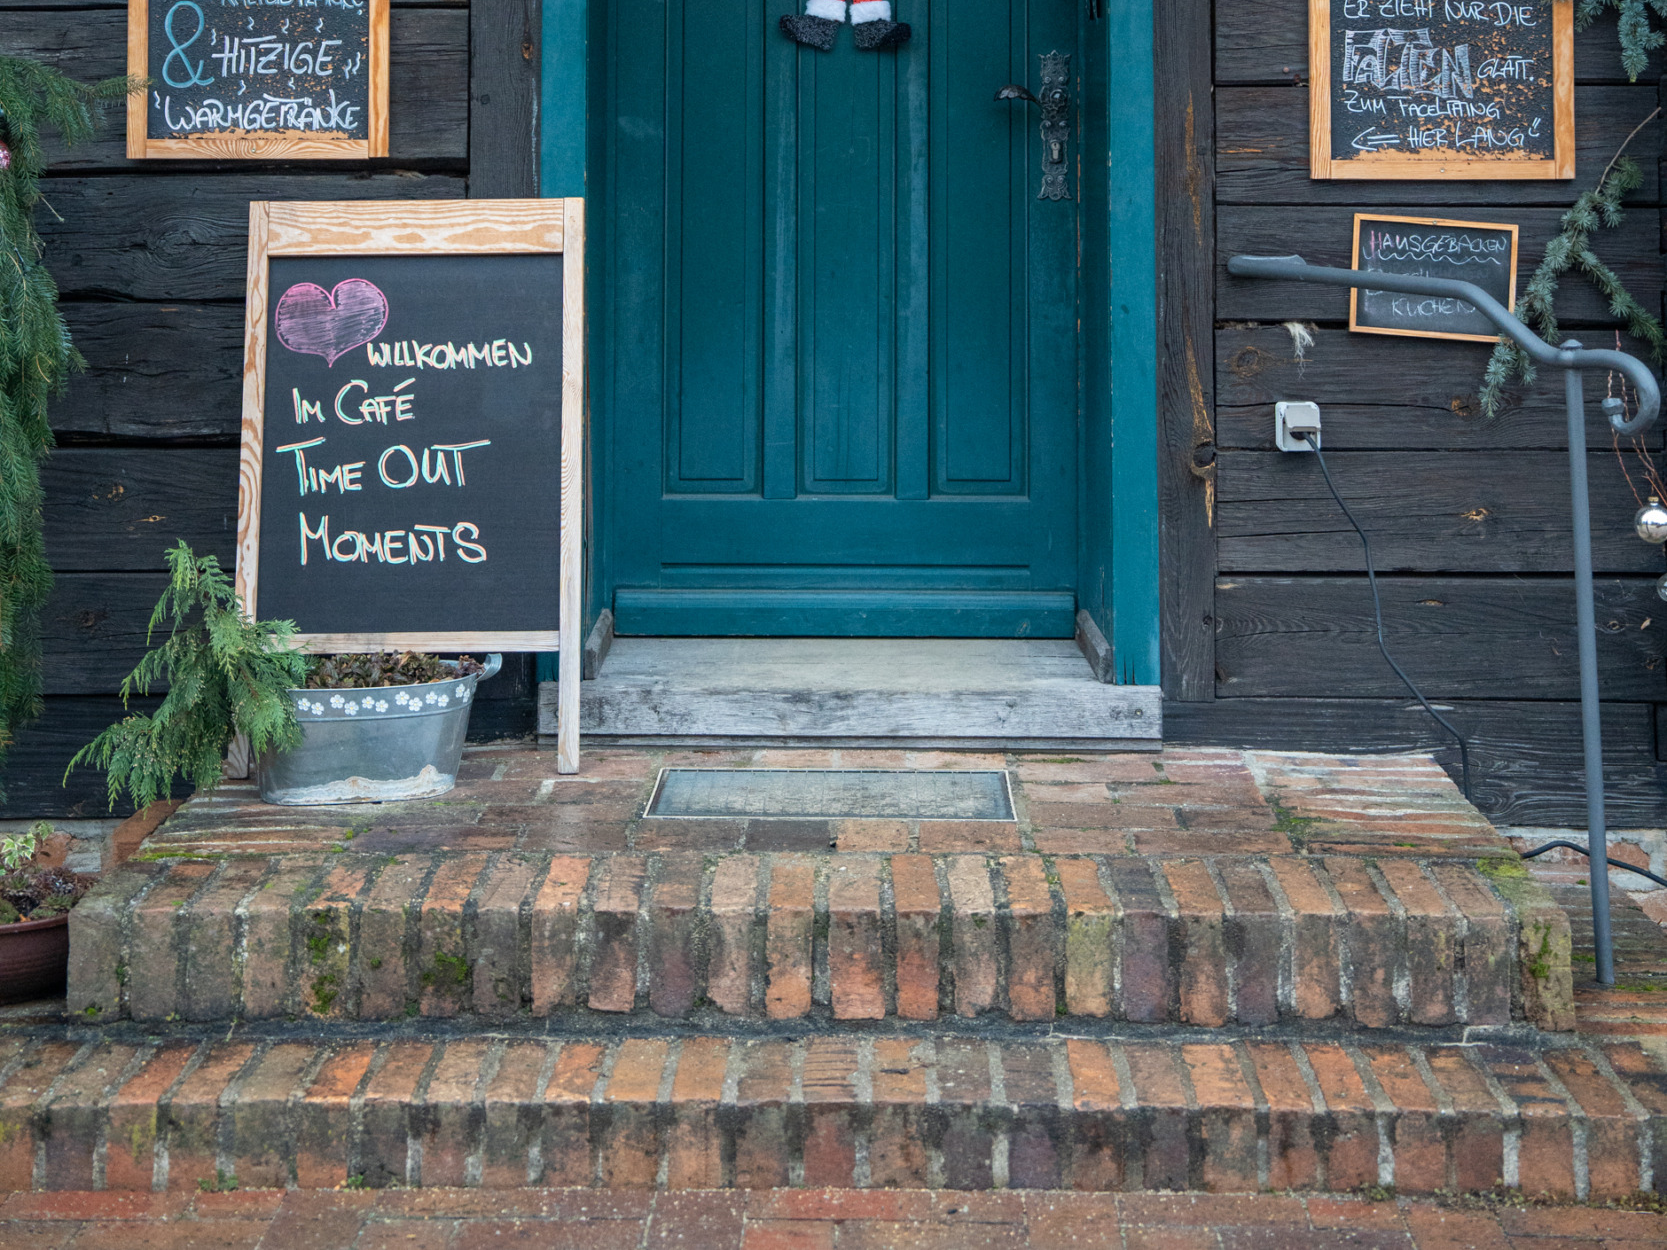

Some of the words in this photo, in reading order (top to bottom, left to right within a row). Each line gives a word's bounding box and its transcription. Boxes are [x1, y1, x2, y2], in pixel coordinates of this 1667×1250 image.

[1444, 0, 1490, 22] NUR
[1488, 1, 1537, 27] DIE
[162, 0, 215, 89] &
[211, 34, 343, 78] HITZIGE
[1343, 27, 1474, 99] FALTEN
[165, 88, 361, 131] WARMGETRÄNKE
[1344, 90, 1386, 115] ZUM
[1407, 125, 1449, 149] HIER
[1369, 229, 1508, 257] HAUSGEBACKEN
[367, 338, 533, 370] WILLKOMMEN
[292, 386, 326, 425] IM
[334, 377, 416, 426] CAFÉ
[276, 436, 367, 497] TIME
[378, 439, 492, 488] OUT
[299, 511, 488, 566] MOMENTS
